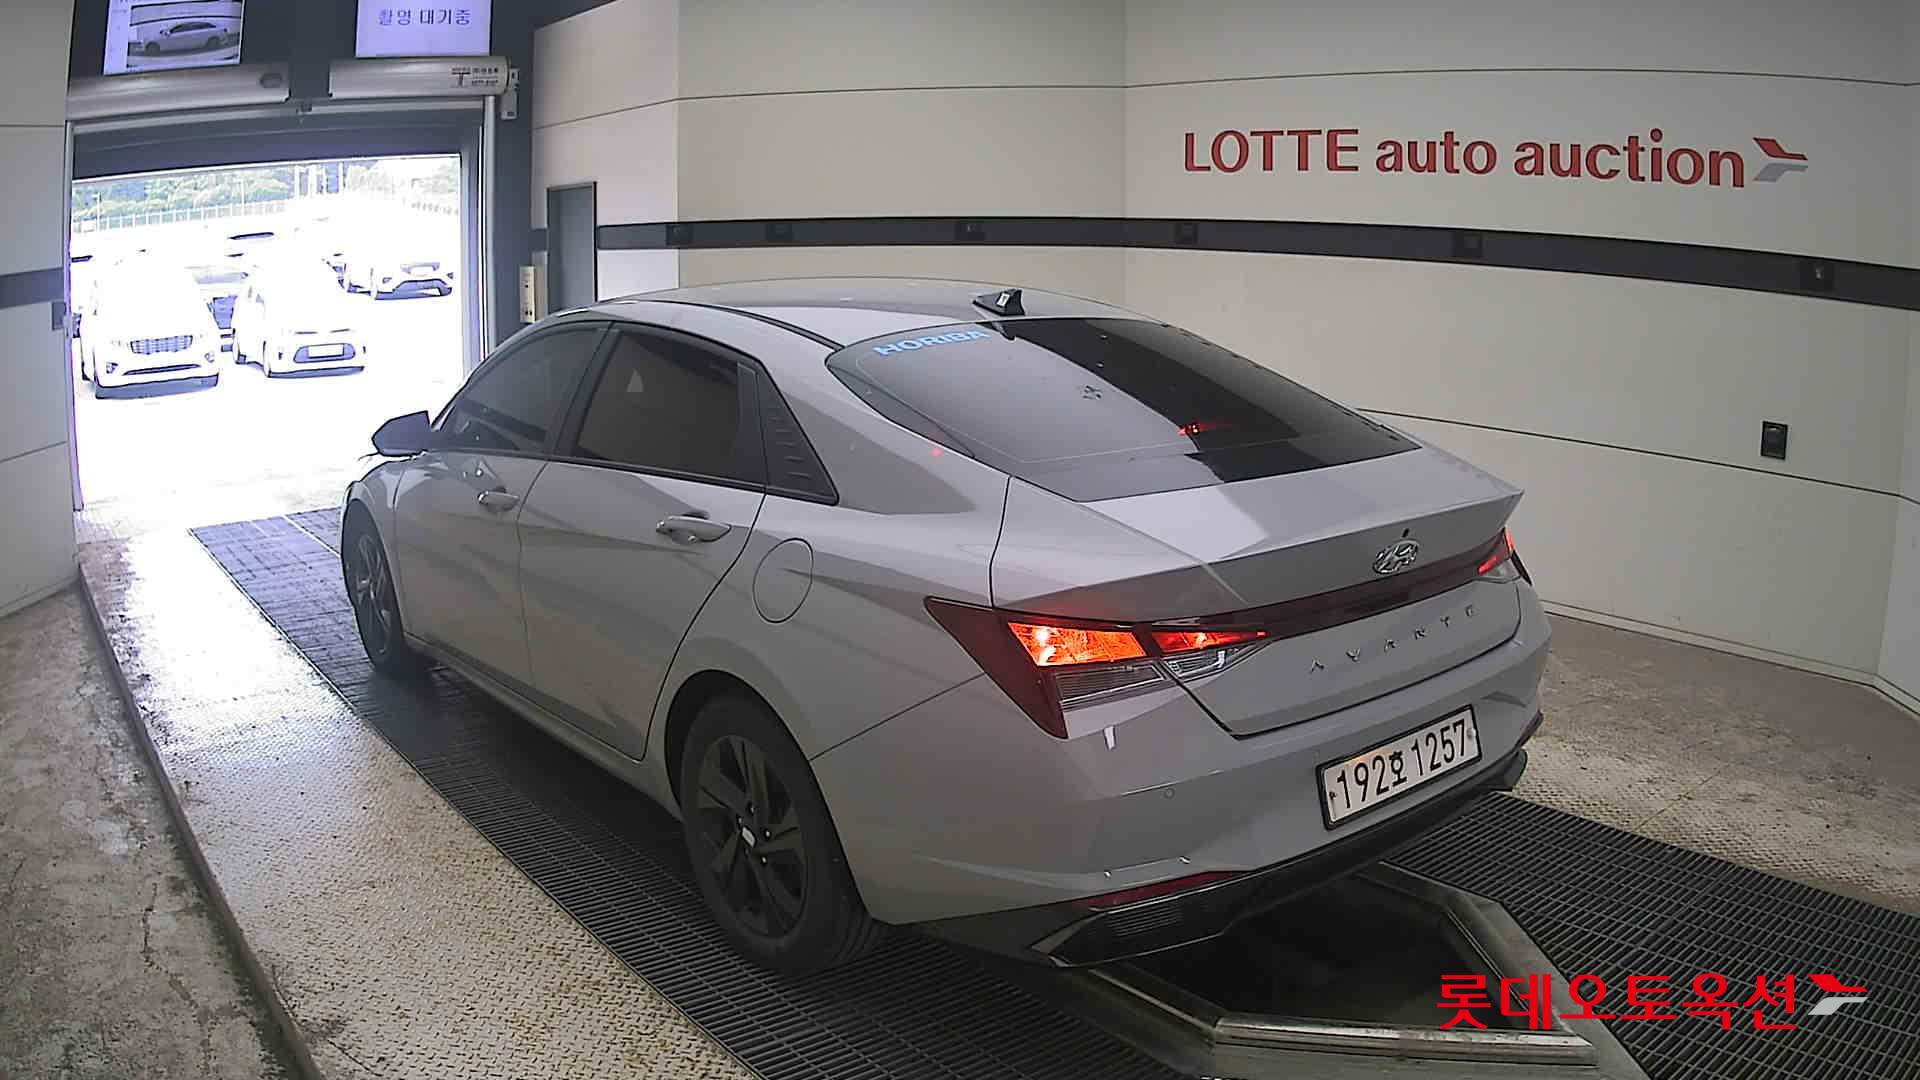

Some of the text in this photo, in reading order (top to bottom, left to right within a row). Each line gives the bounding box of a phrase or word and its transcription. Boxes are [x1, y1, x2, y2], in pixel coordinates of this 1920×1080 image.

[419, 9, 471, 26] 대기중
[1184, 128, 1745, 188] LOTTE auto auction
[873, 330, 990, 356] HORIBA
[1310, 605, 1475, 673] AVANTE
[1336, 718, 1466, 809] 192호 1257
